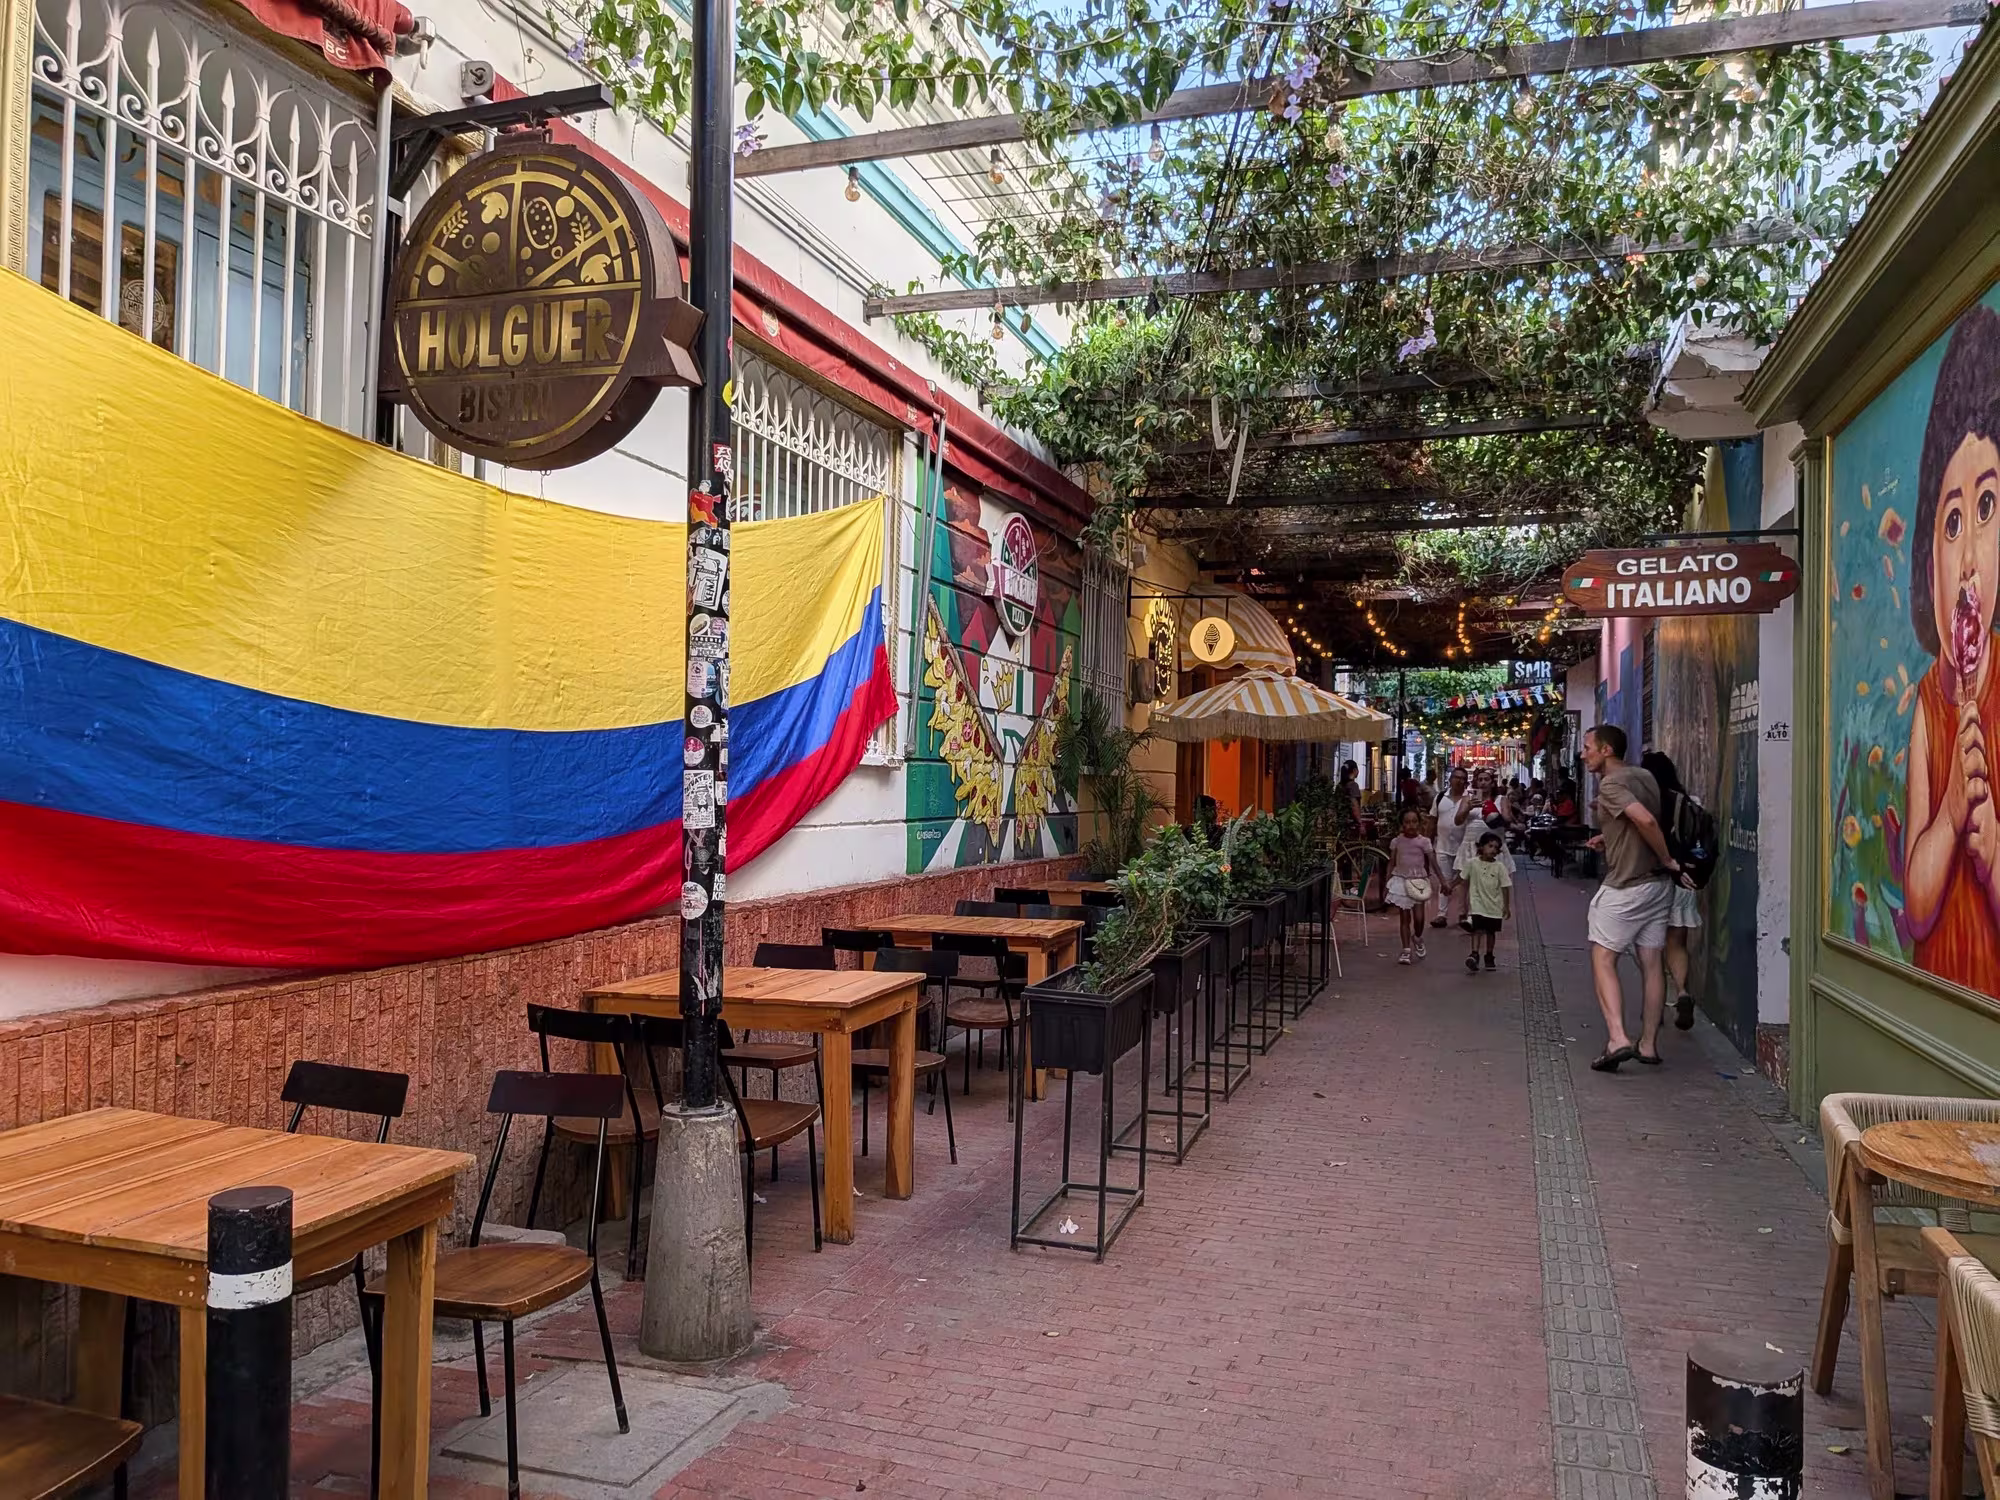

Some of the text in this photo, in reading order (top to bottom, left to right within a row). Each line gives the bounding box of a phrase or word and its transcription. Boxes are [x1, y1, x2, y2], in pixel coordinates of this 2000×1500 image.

[418, 297, 613, 372] HOLGUER
[1616, 553, 1738, 576] GELATO
[1607, 576, 1752, 609] ITALIANO
[1514, 660, 1552, 678] SMR
